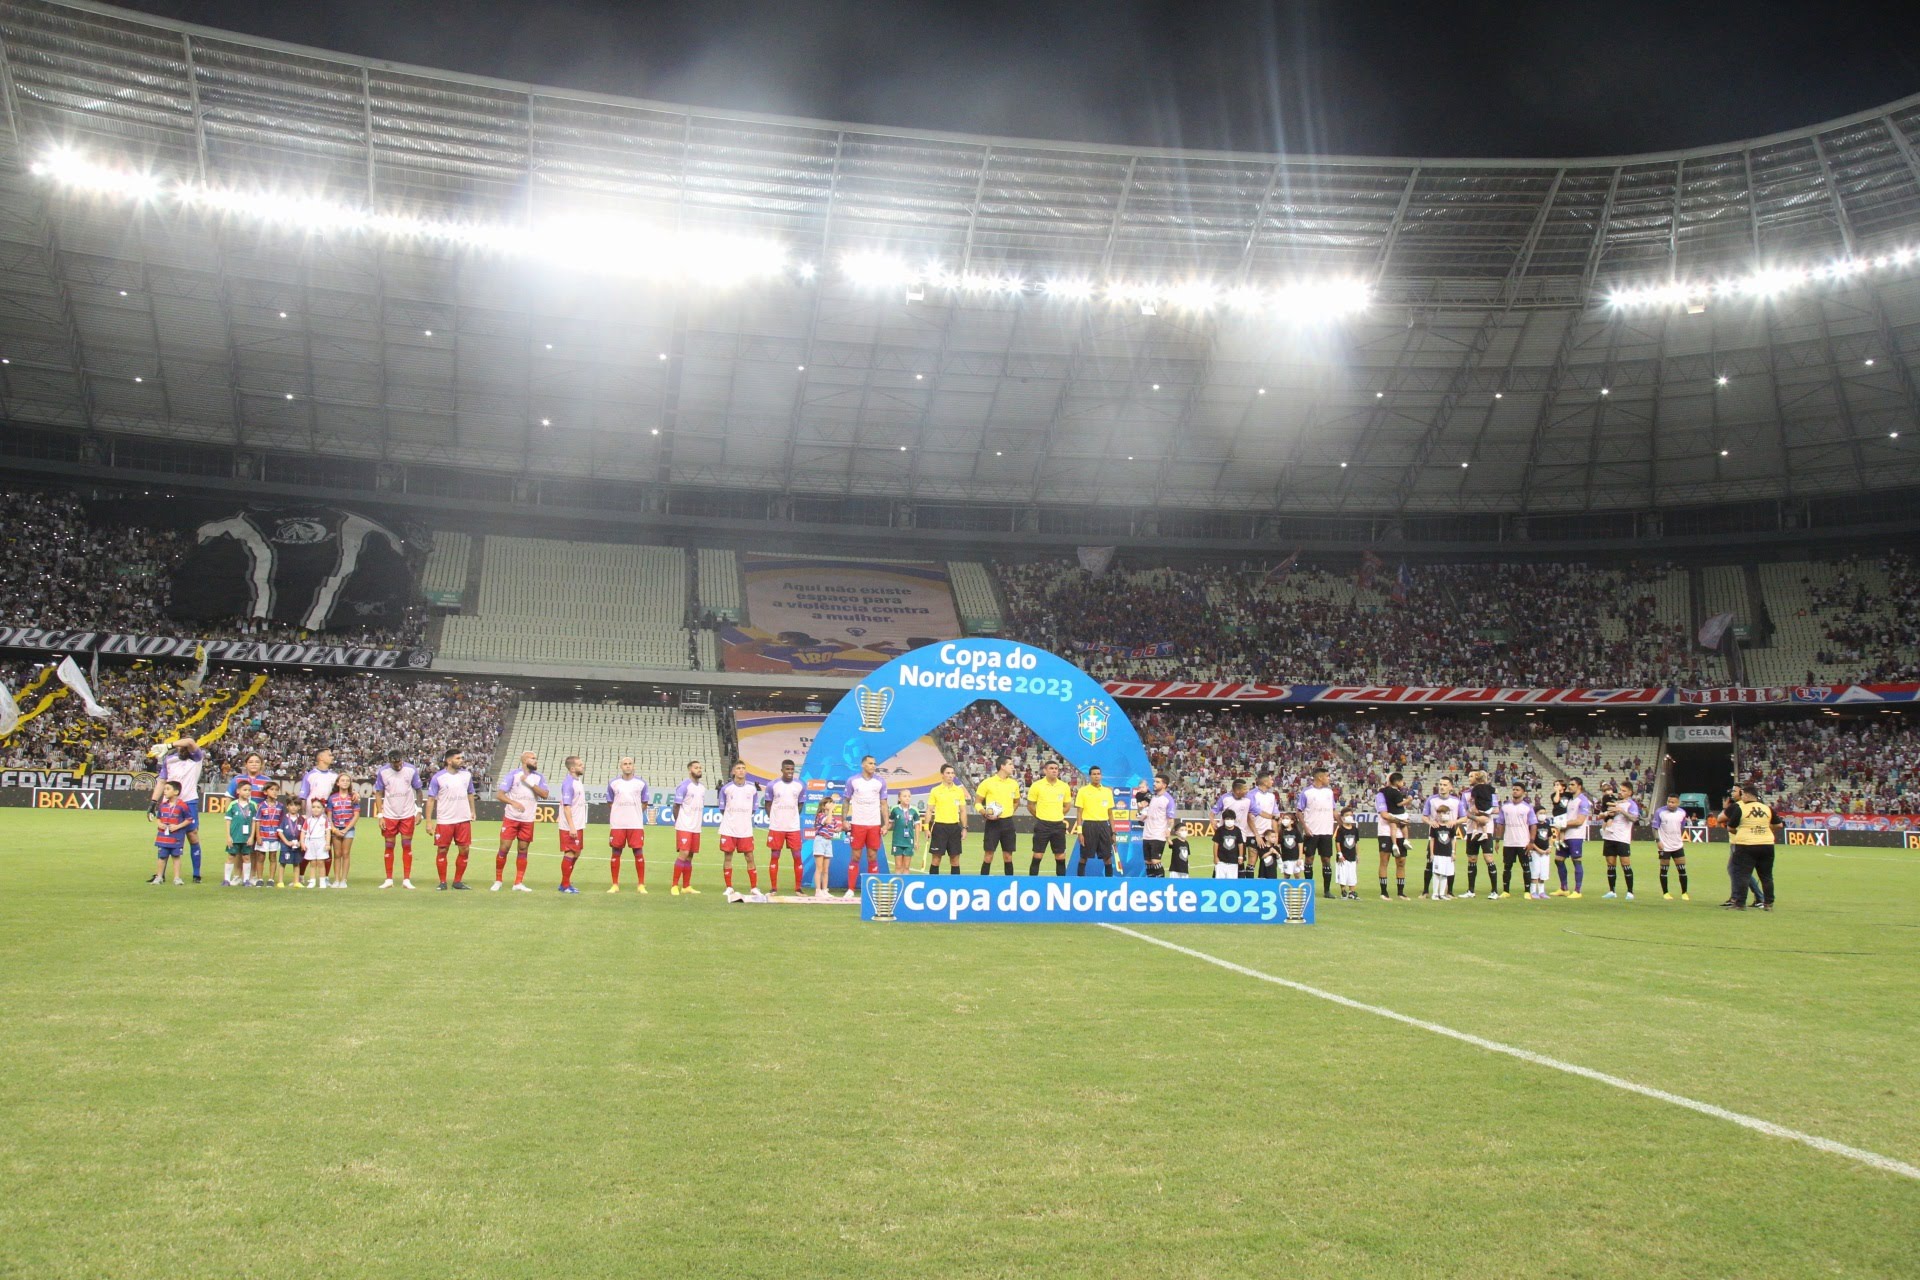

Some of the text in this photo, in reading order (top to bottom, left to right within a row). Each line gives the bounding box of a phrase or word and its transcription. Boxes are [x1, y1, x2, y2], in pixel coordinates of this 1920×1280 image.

[782, 582, 912, 595] Aqui não existe
[796, 593, 902, 605] espaço para
[787, 600, 869, 612] violência
[872, 604, 930, 615] contra
[940, 643, 1037, 672] Copa do
[899, 664, 1073, 702] Nordeste 2023
[1702, 689, 1766, 702] BEER
[1688, 727, 1726, 736] CEARÁ
[38, 791, 95, 810] BRAX
[1185, 822, 1215, 837] BRA
[1681, 829, 1703, 843] AX
[1788, 832, 1825, 846] BRAX
[903, 880, 1278, 921] Copa do Nordeste 2023
